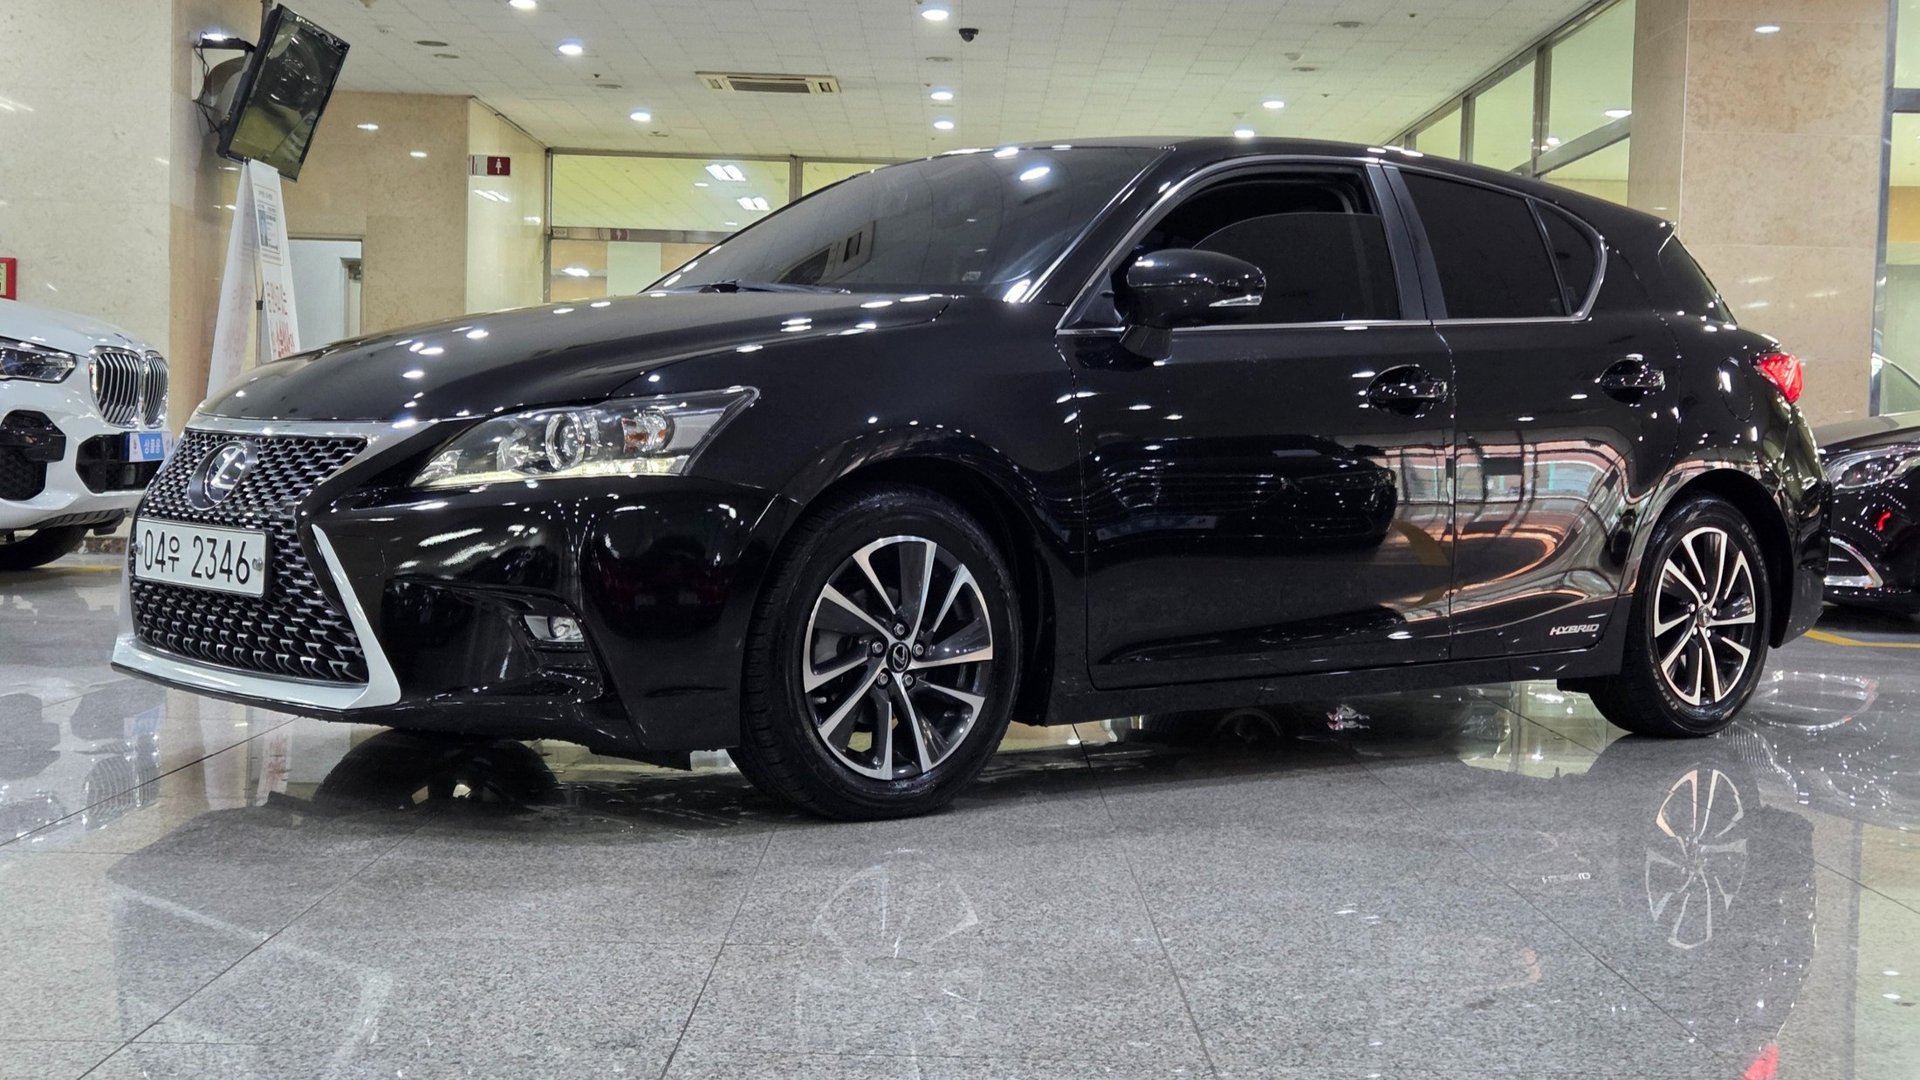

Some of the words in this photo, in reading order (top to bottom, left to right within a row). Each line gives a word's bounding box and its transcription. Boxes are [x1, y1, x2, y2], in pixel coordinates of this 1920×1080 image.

[144, 529, 180, 573] 04우
[191, 535, 250, 585] 2346
[1549, 623, 1600, 636] HYBRID
